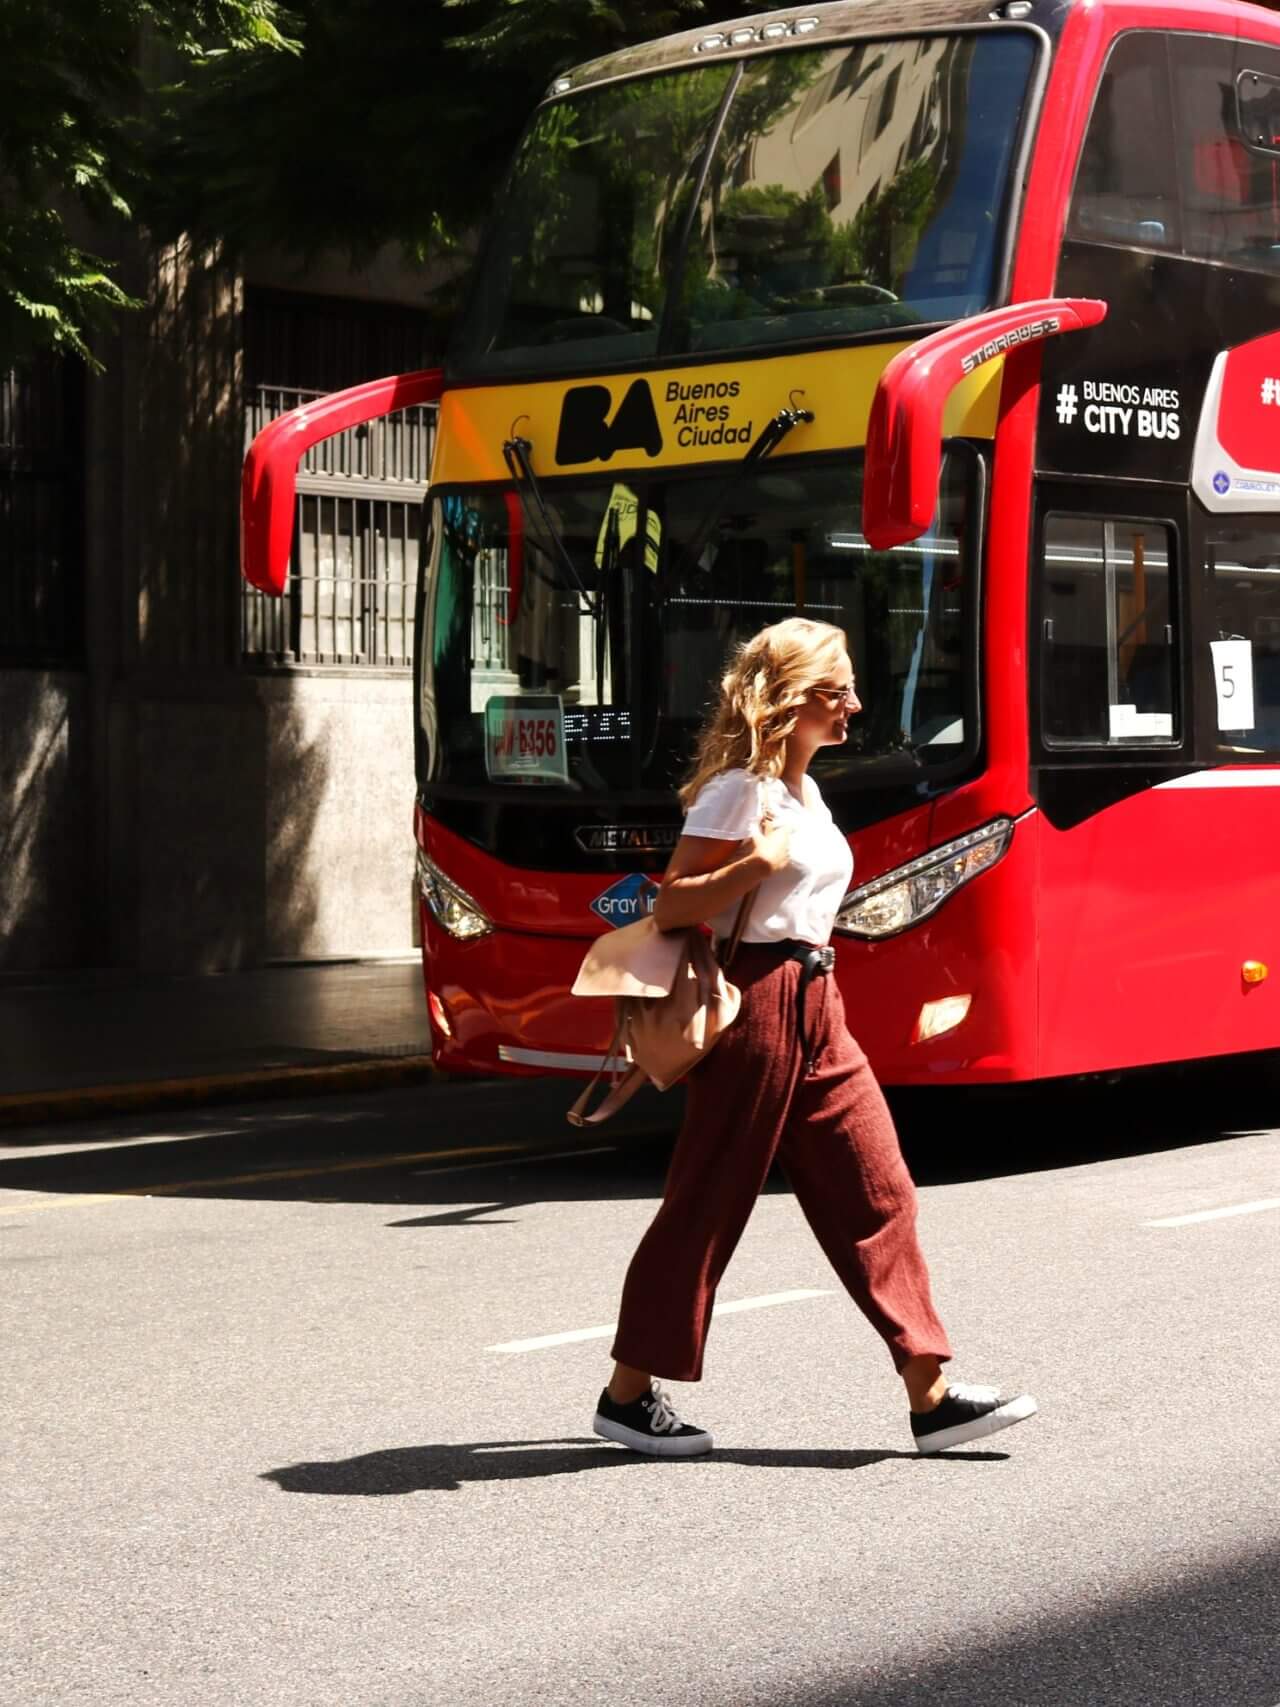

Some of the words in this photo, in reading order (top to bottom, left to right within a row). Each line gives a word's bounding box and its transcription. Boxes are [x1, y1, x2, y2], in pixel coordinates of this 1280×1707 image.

[665, 380, 740, 402] Buenos
[1083, 380, 1140, 404] BUENOS
[1142, 387, 1179, 409] AIRES
[555, 378, 663, 466] BA
[673, 404, 729, 424] Aires
[1084, 404, 1133, 435] CITY
[1137, 408, 1180, 440] BUS
[677, 420, 752, 447] Ciudad
[1222, 665, 1236, 699] 5
